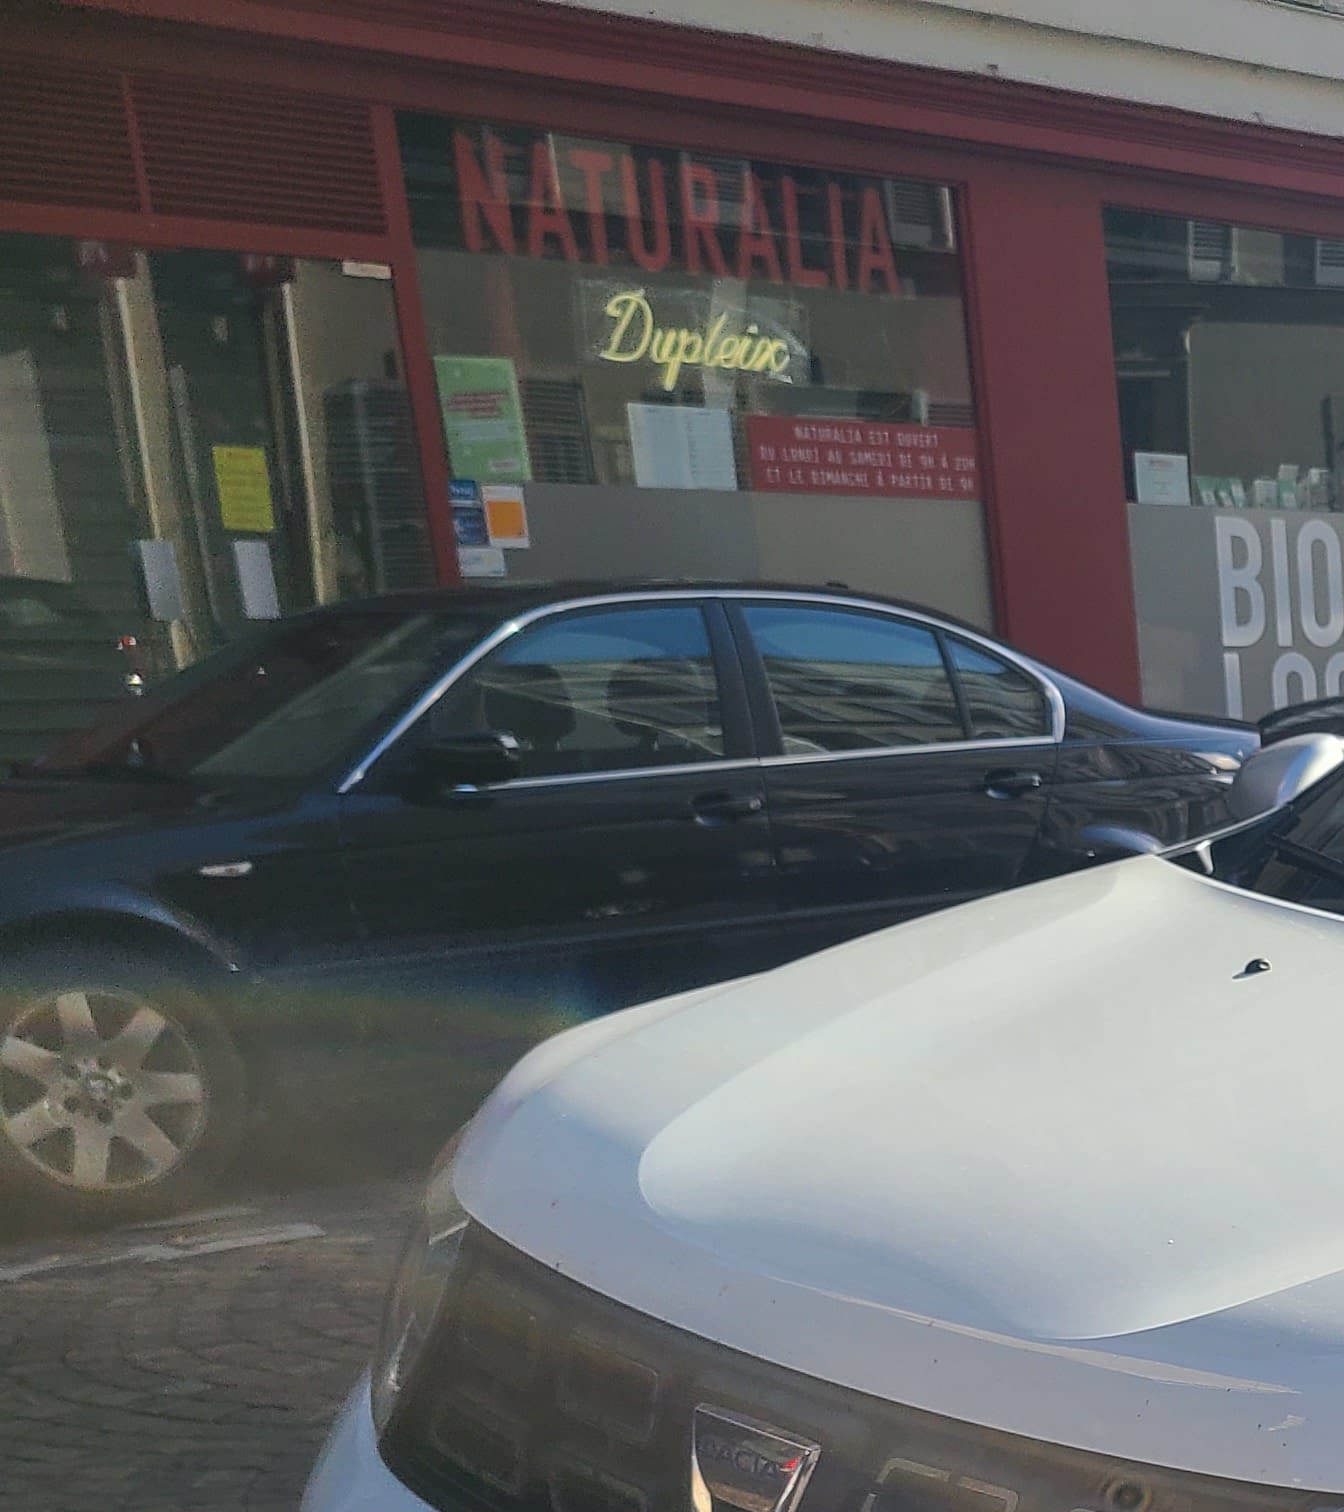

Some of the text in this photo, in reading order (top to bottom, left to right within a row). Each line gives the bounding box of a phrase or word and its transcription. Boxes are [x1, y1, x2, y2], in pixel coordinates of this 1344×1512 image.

[451, 130, 900, 296] NATURALIA
[602, 289, 791, 391] Dupleix
[760, 445, 775, 461] DU
[783, 447, 819, 463] LUNDI
[827, 449, 843, 464] AU
[849, 451, 893, 467] SAMEDI
[794, 425, 939, 447] NATURALIA EST OUVERT
[811, 470, 869, 488] DIMANCHE
[1214, 516, 1344, 648] BIO
[695, 1437, 778, 1478] DACIA
